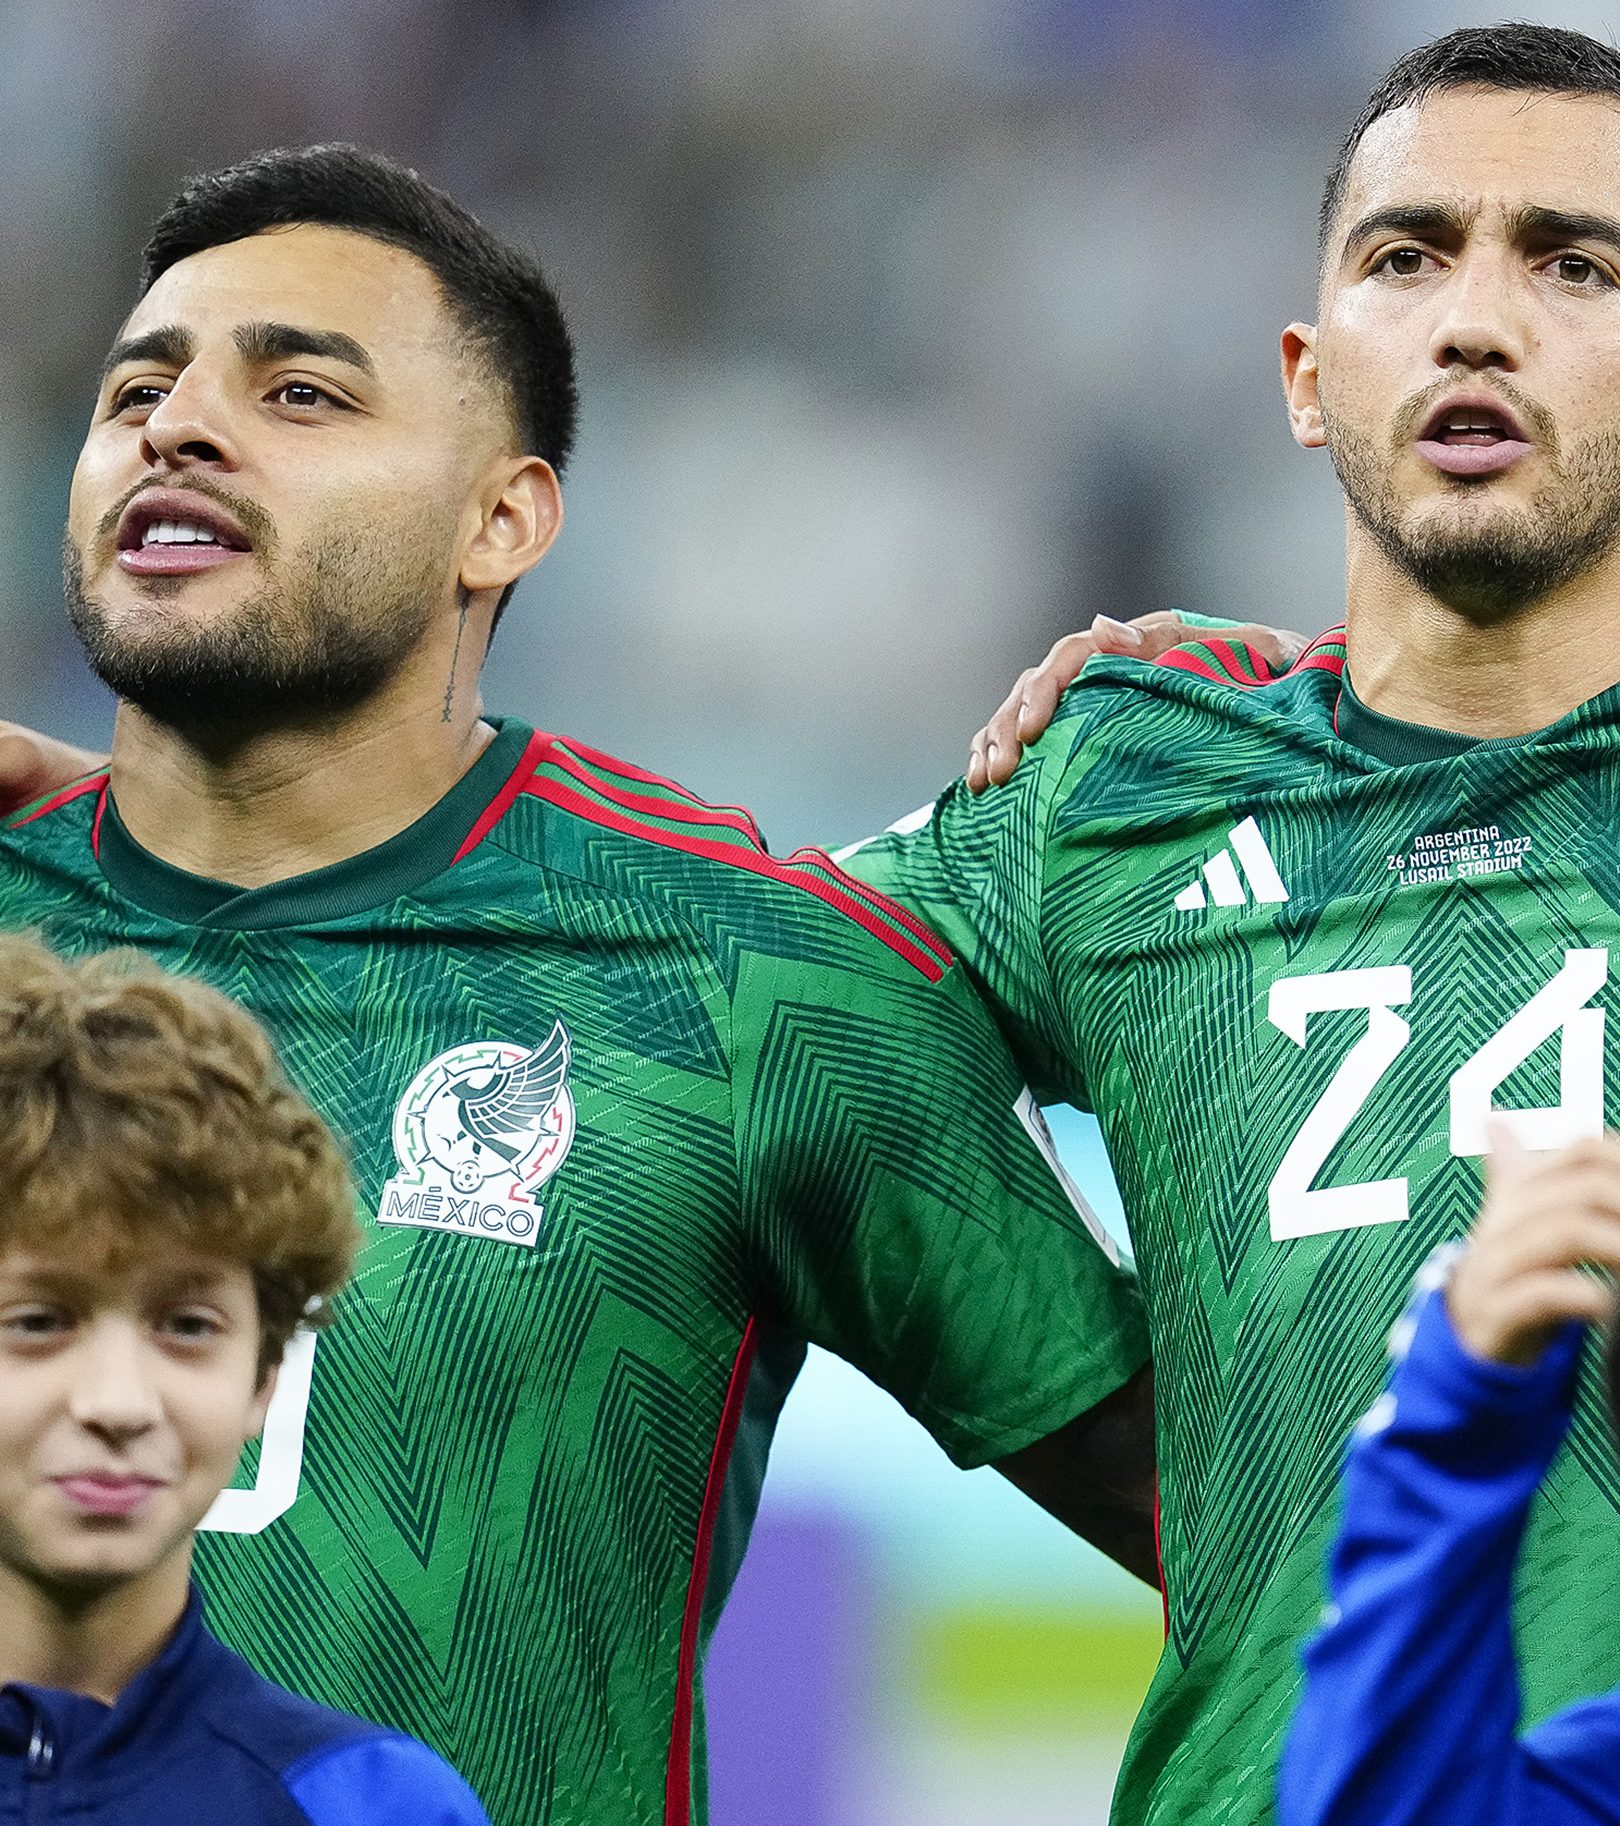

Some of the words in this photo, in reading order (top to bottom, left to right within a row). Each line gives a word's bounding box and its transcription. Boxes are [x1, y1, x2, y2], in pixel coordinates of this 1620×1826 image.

[1386, 855, 1405, 870] 26
[1409, 843, 1490, 867] NOVEMBER
[1493, 836, 1532, 856] 2022
[1414, 825, 1499, 850] ARGENTINA
[1399, 866, 1453, 885] LUSAIL
[1456, 854, 1522, 877] STADIUM
[1268, 947, 1608, 1242] 24
[386, 1186, 534, 1237] MÉXICO
